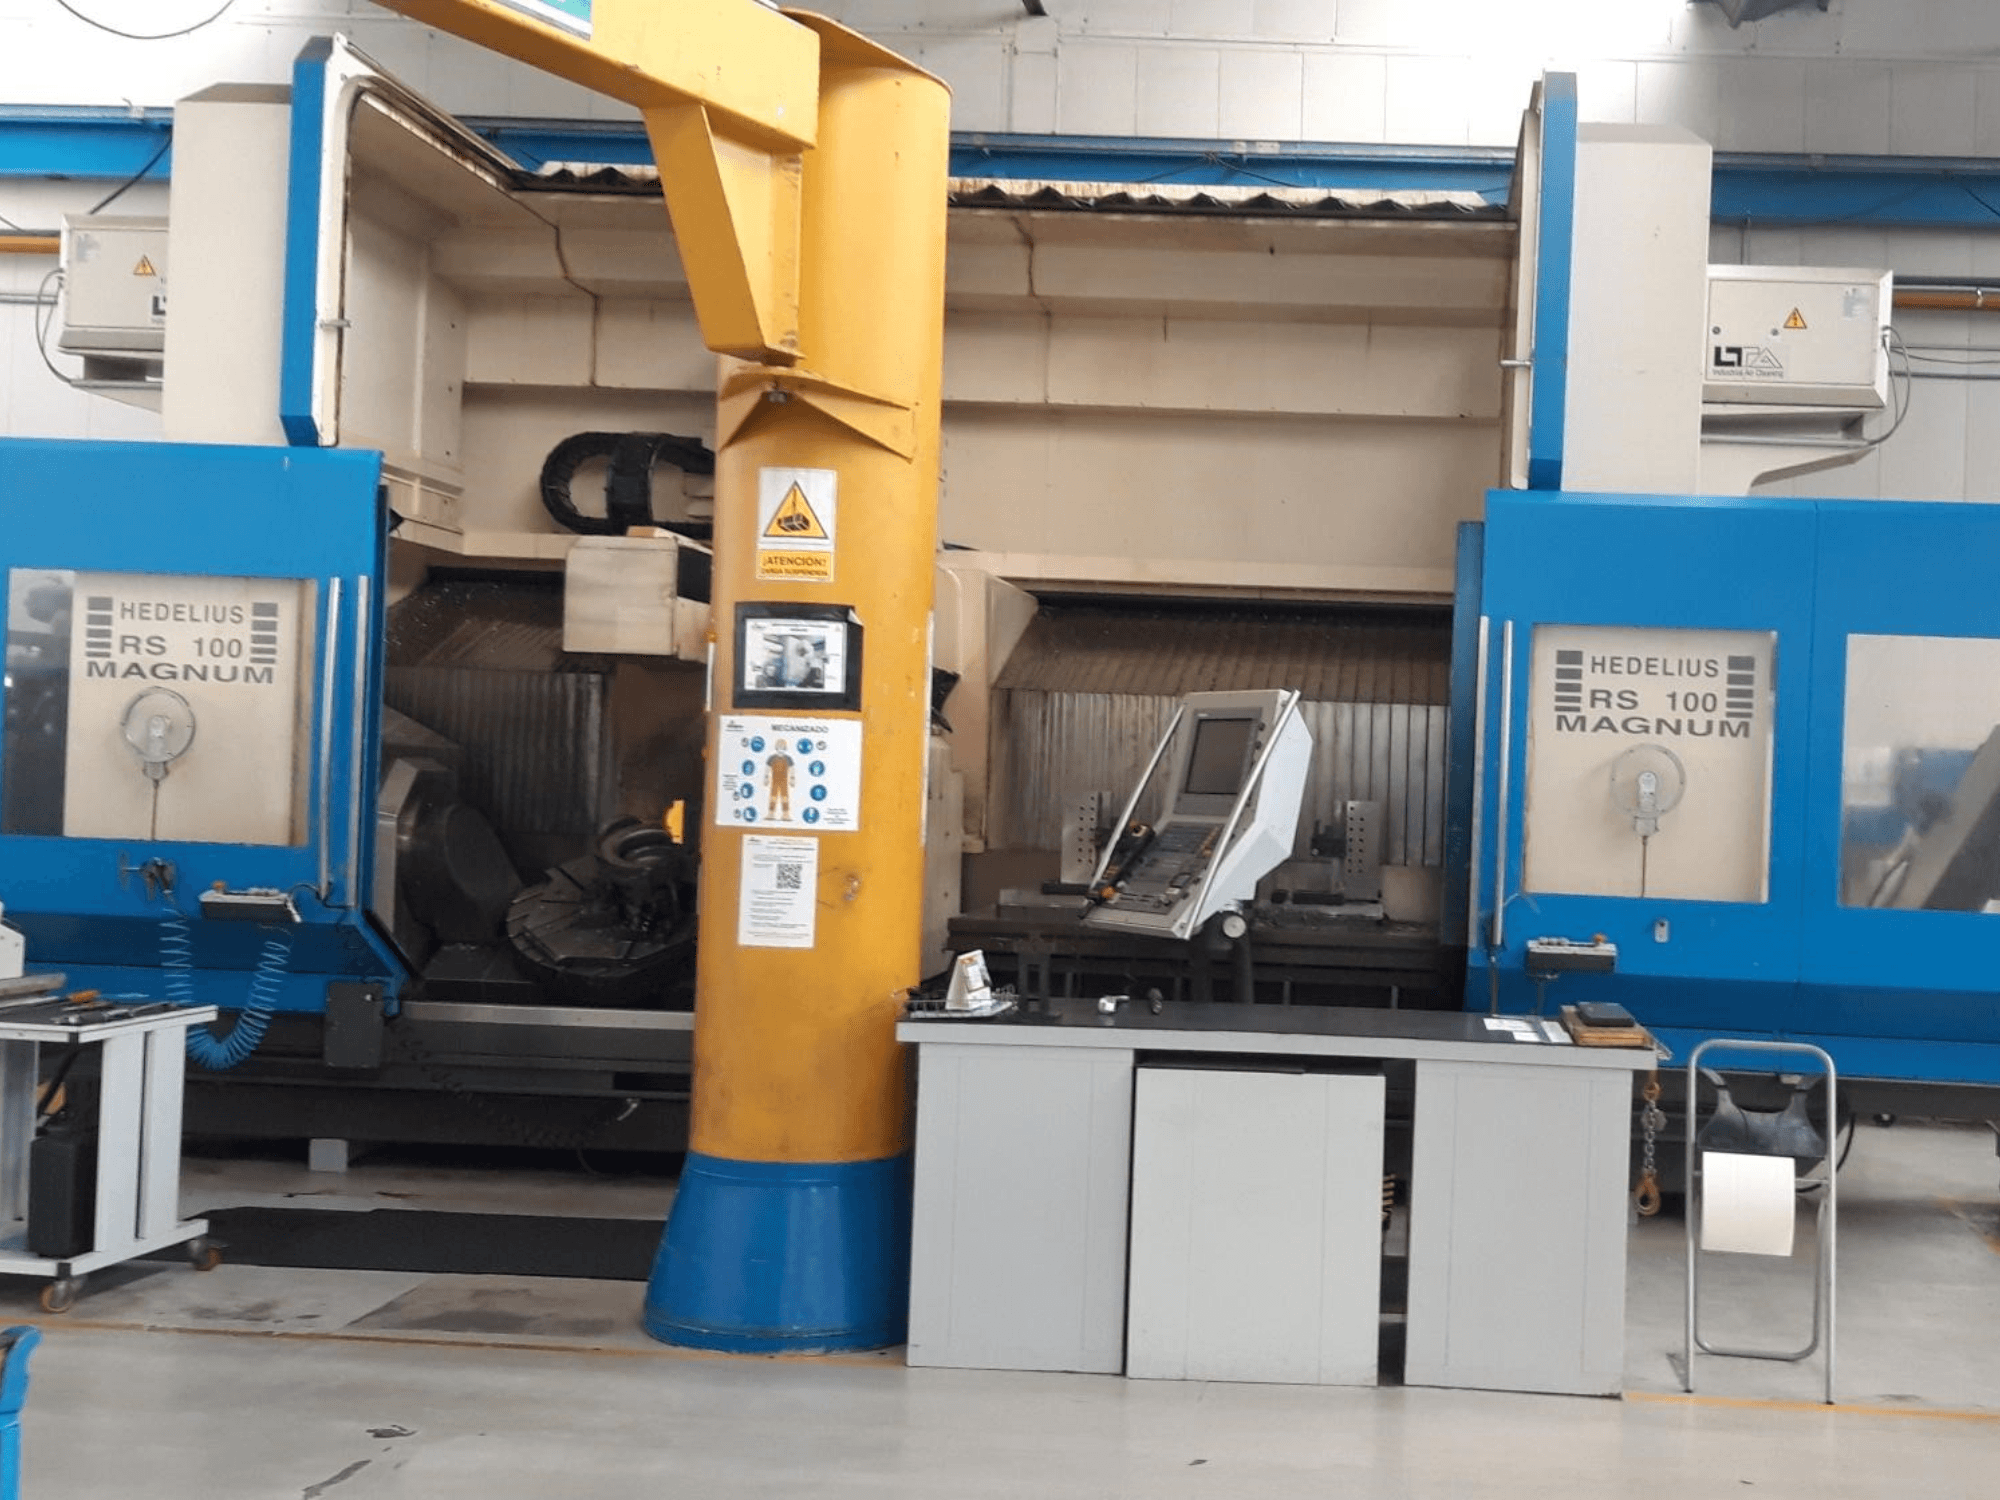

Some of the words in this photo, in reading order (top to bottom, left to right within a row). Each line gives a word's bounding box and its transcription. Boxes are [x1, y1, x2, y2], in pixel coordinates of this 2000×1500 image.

[120, 601, 244, 624] HEDELIUS
[119, 635, 167, 655] RS
[193, 637, 243, 659] 100
[86, 660, 274, 684] MAGNUM
[1591, 655, 1719, 677] HEDELIUS
[1589, 689, 1639, 710] RS
[1666, 691, 1718, 712] 100
[1555, 714, 1751, 738] MAGNUM
